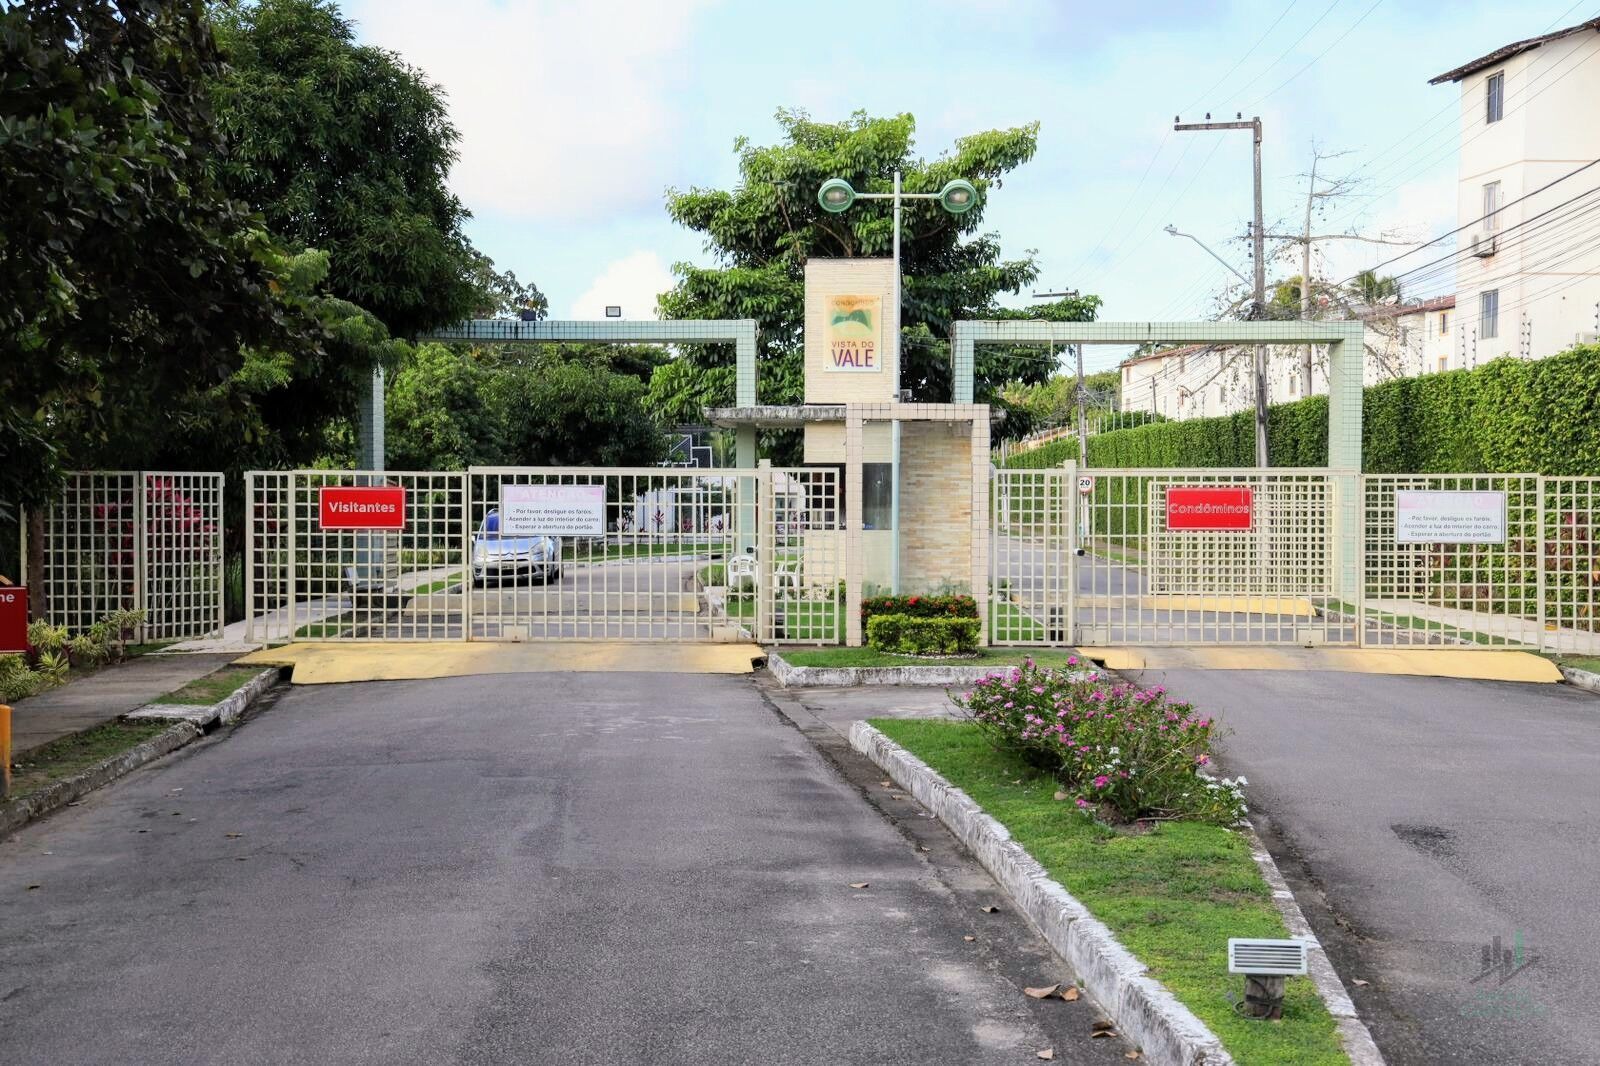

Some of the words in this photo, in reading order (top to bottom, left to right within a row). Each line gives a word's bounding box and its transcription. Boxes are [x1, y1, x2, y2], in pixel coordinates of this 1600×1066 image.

[831, 349, 874, 368] VALE
[328, 501, 396, 513] Visitantes
[543, 508, 566, 516] desligue
[1168, 502, 1249, 514] Condôminos
